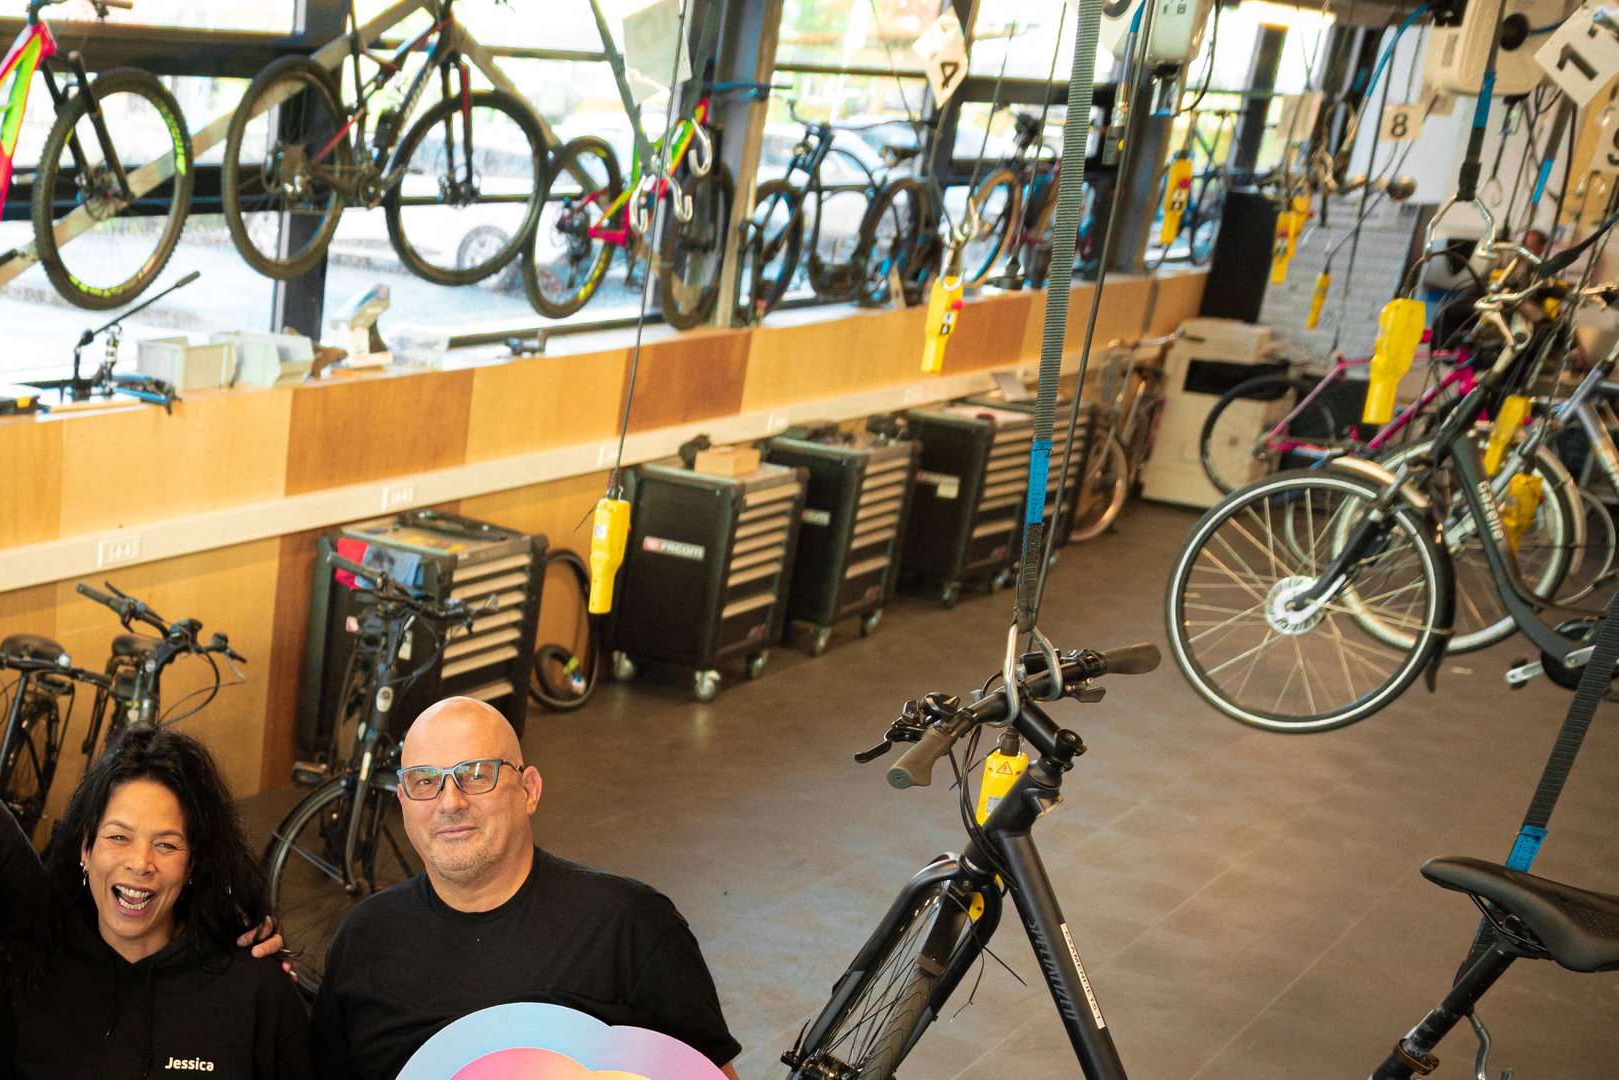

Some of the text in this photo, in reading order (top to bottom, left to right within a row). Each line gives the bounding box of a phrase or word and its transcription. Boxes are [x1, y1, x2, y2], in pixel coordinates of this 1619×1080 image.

[940, 61, 960, 89] 4
[1391, 112, 1408, 138] 8
[1477, 480, 1504, 540] Gazelle
[1027, 917, 1080, 1021] SPECIALIZED
[164, 1056, 215, 1072] Jessica
